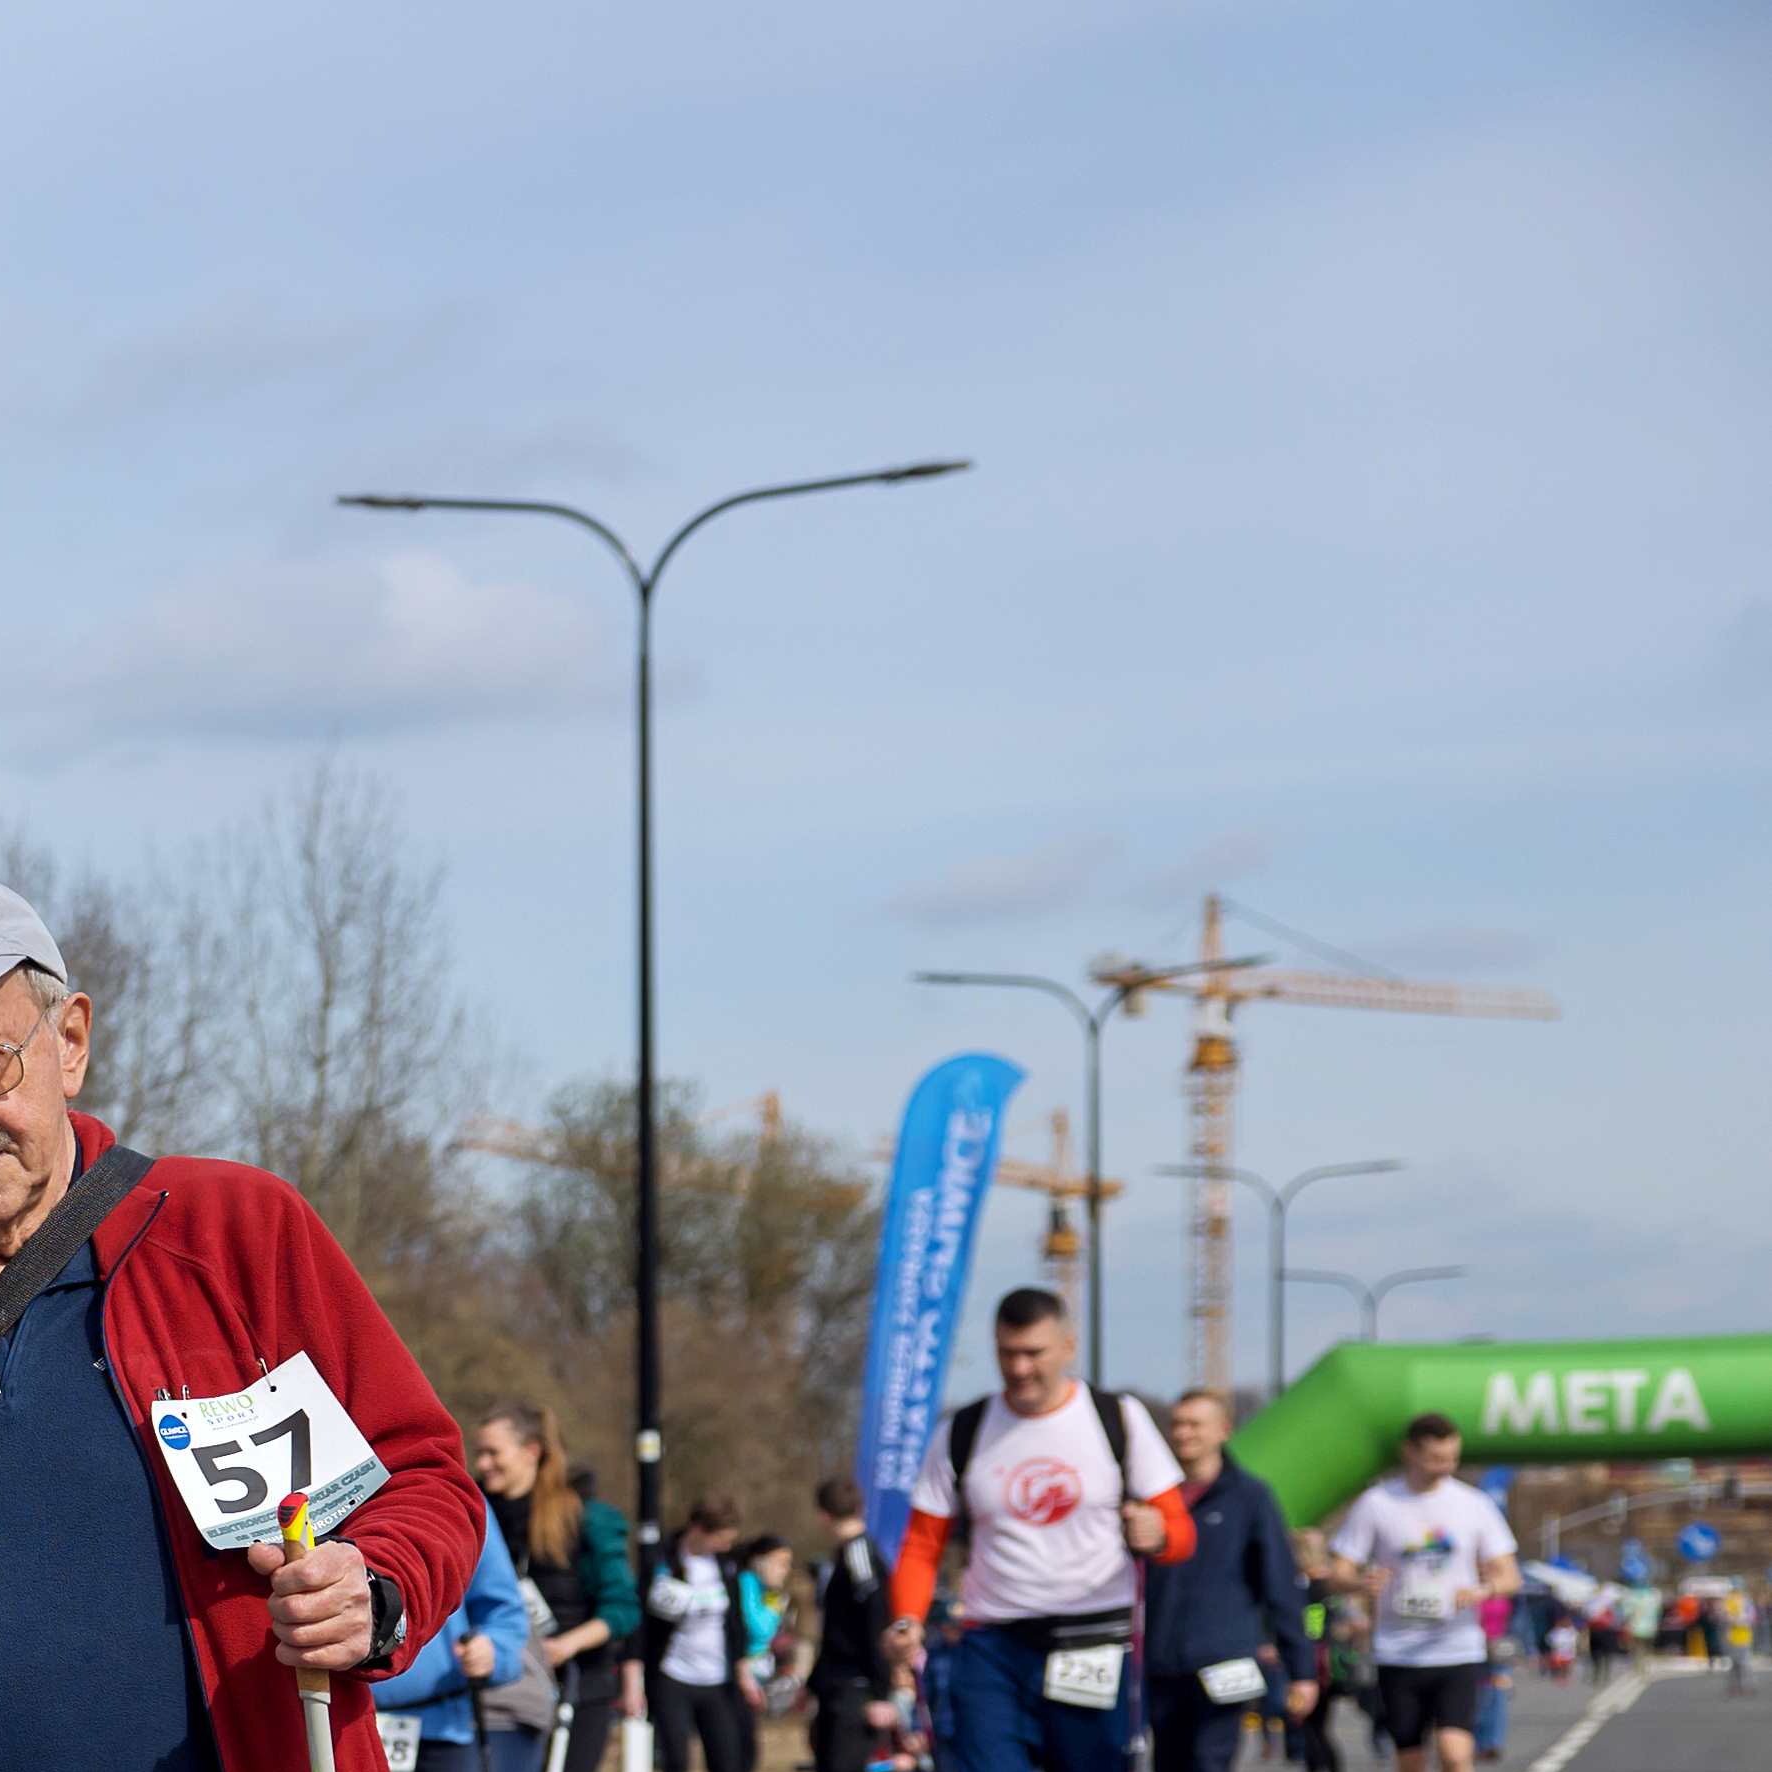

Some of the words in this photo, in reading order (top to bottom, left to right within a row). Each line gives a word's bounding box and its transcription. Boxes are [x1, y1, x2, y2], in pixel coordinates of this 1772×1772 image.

[199, 1394, 253, 1418] REWO
[1484, 1368, 1711, 1434] META
[206, 1408, 255, 1425] SPORT
[191, 1408, 312, 1514] 57
[341, 1461, 377, 1486] CZASU
[310, 1504, 352, 1532] WROTNY
